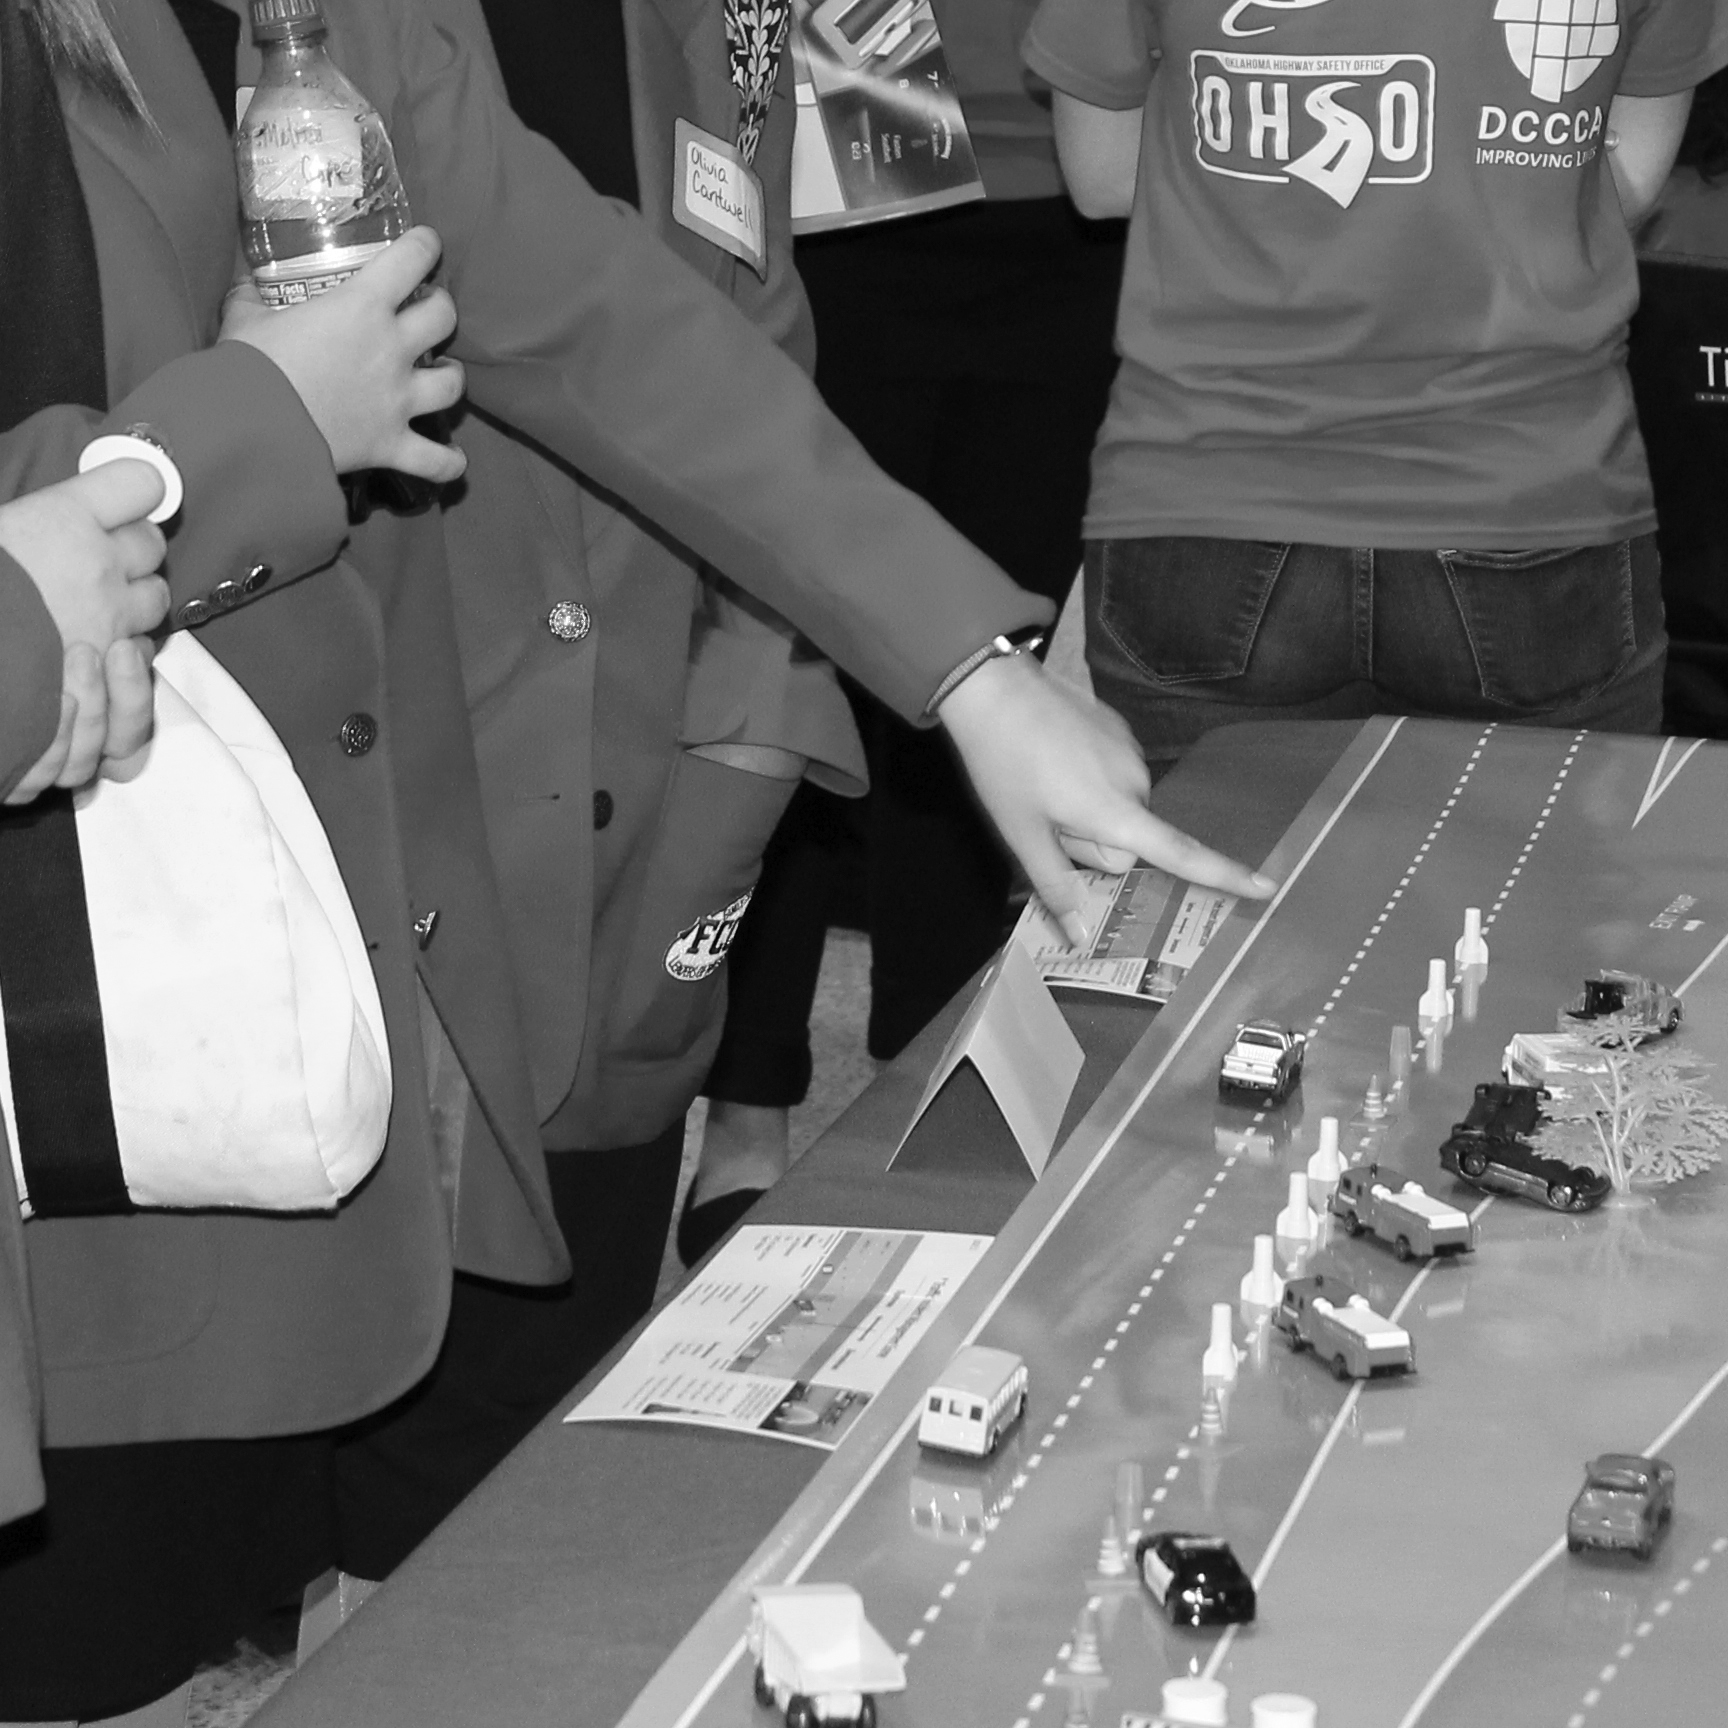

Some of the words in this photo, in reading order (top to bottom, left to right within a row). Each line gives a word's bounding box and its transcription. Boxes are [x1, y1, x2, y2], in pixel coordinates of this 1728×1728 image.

[1225, 57, 1271, 70] OKLAHOMA
[1273, 58, 1314, 71] HIGHWAY
[1316, 58, 1352, 71] SAFETY
[1354, 58, 1385, 71] OFFICE
[1478, 105, 1603, 145] DCCCA
[691, 147, 729, 184] Olivia
[692, 169, 752, 229] Cantwell
[279, 282, 306, 298] Facts
